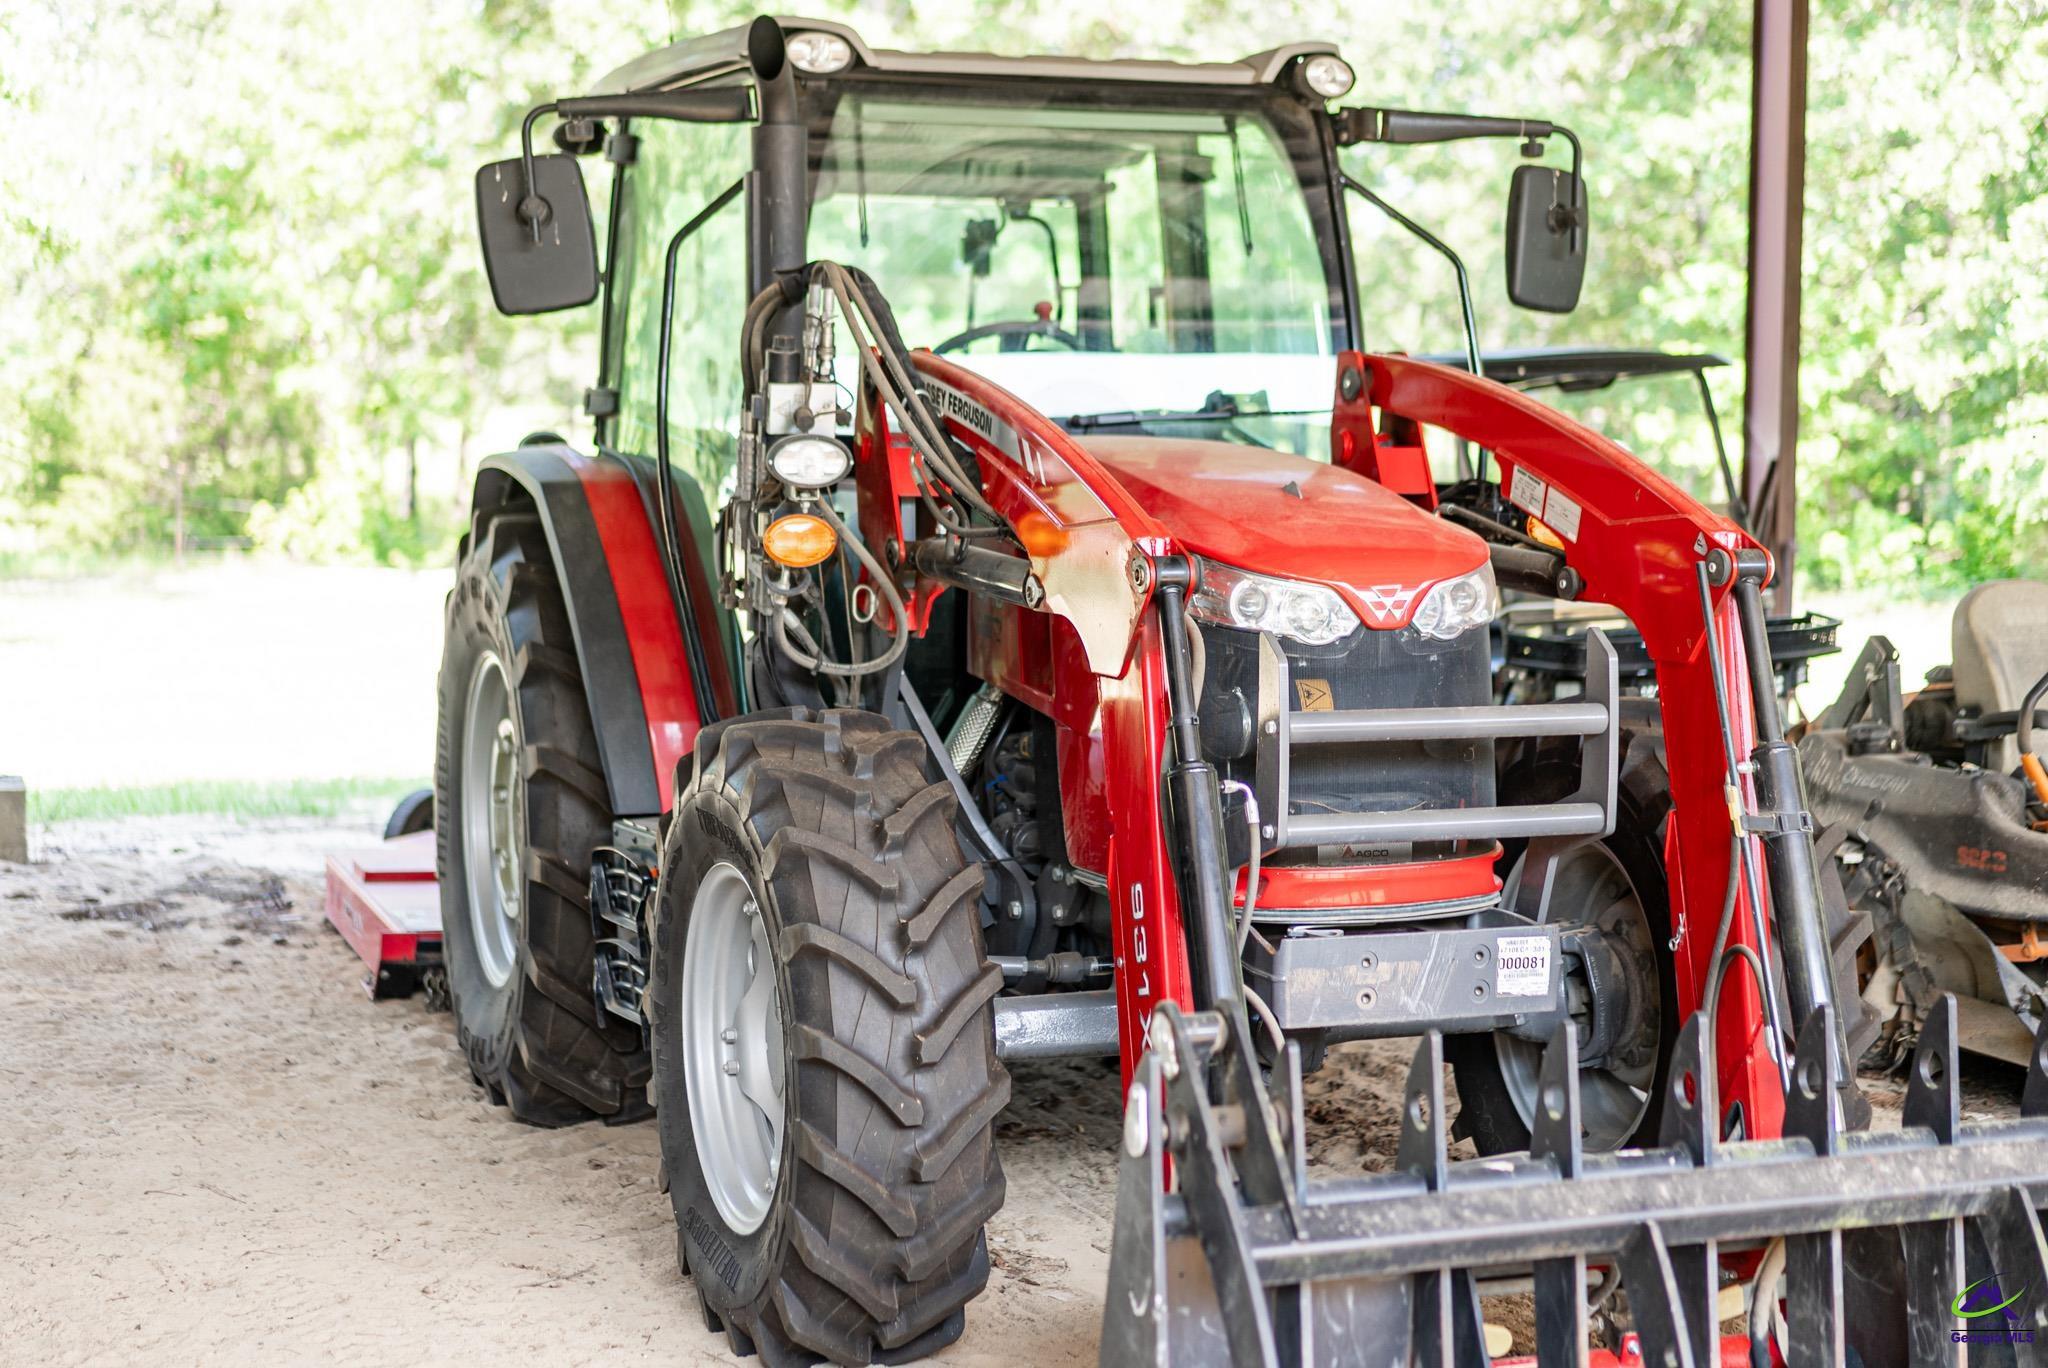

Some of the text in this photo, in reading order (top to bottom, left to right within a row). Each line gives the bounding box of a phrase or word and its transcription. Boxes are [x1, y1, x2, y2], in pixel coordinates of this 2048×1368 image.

[948, 392, 993, 437] FERGUSON
[1356, 849, 1389, 858] AGCO
[684, 1205, 742, 1294] TRELLEBORG
